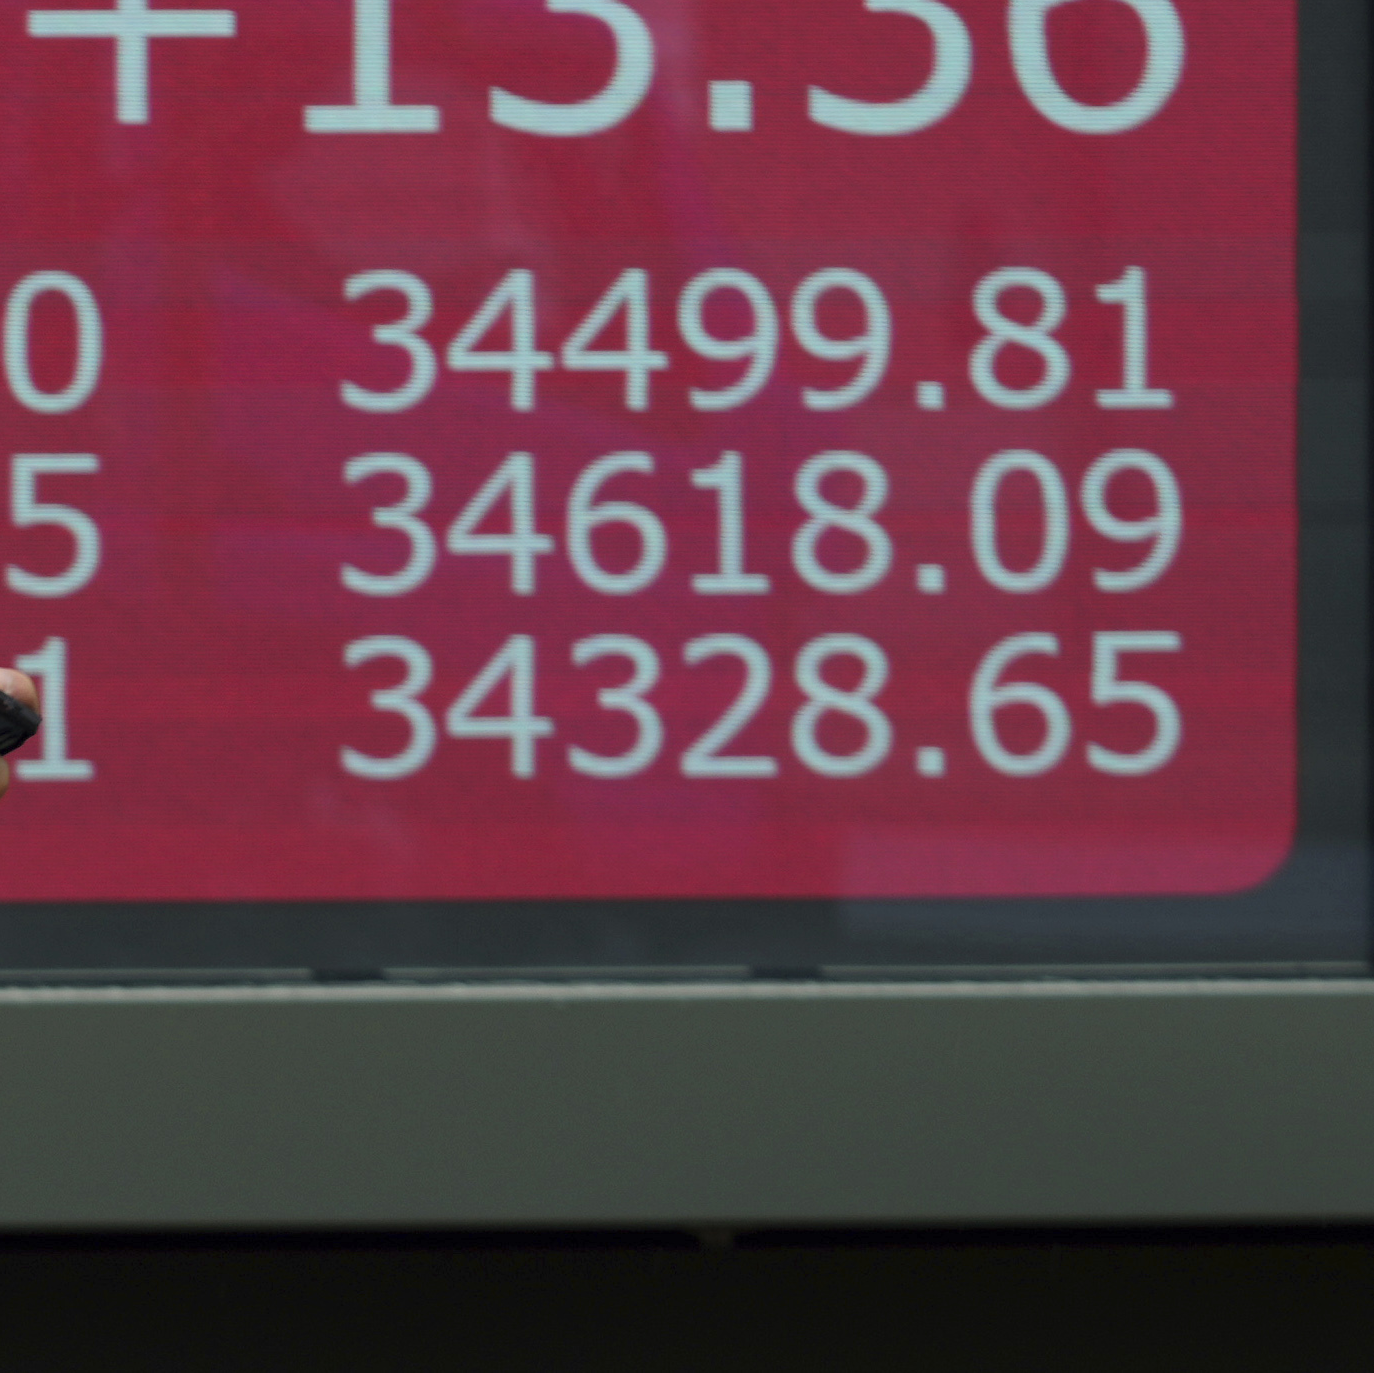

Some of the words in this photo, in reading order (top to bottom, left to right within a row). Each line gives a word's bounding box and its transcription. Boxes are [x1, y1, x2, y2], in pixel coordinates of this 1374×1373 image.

[341, 266, 1173, 413] 34499.81
[341, 448, 1183, 597] 34618.09
[341, 631, 1181, 780] 34328.65
